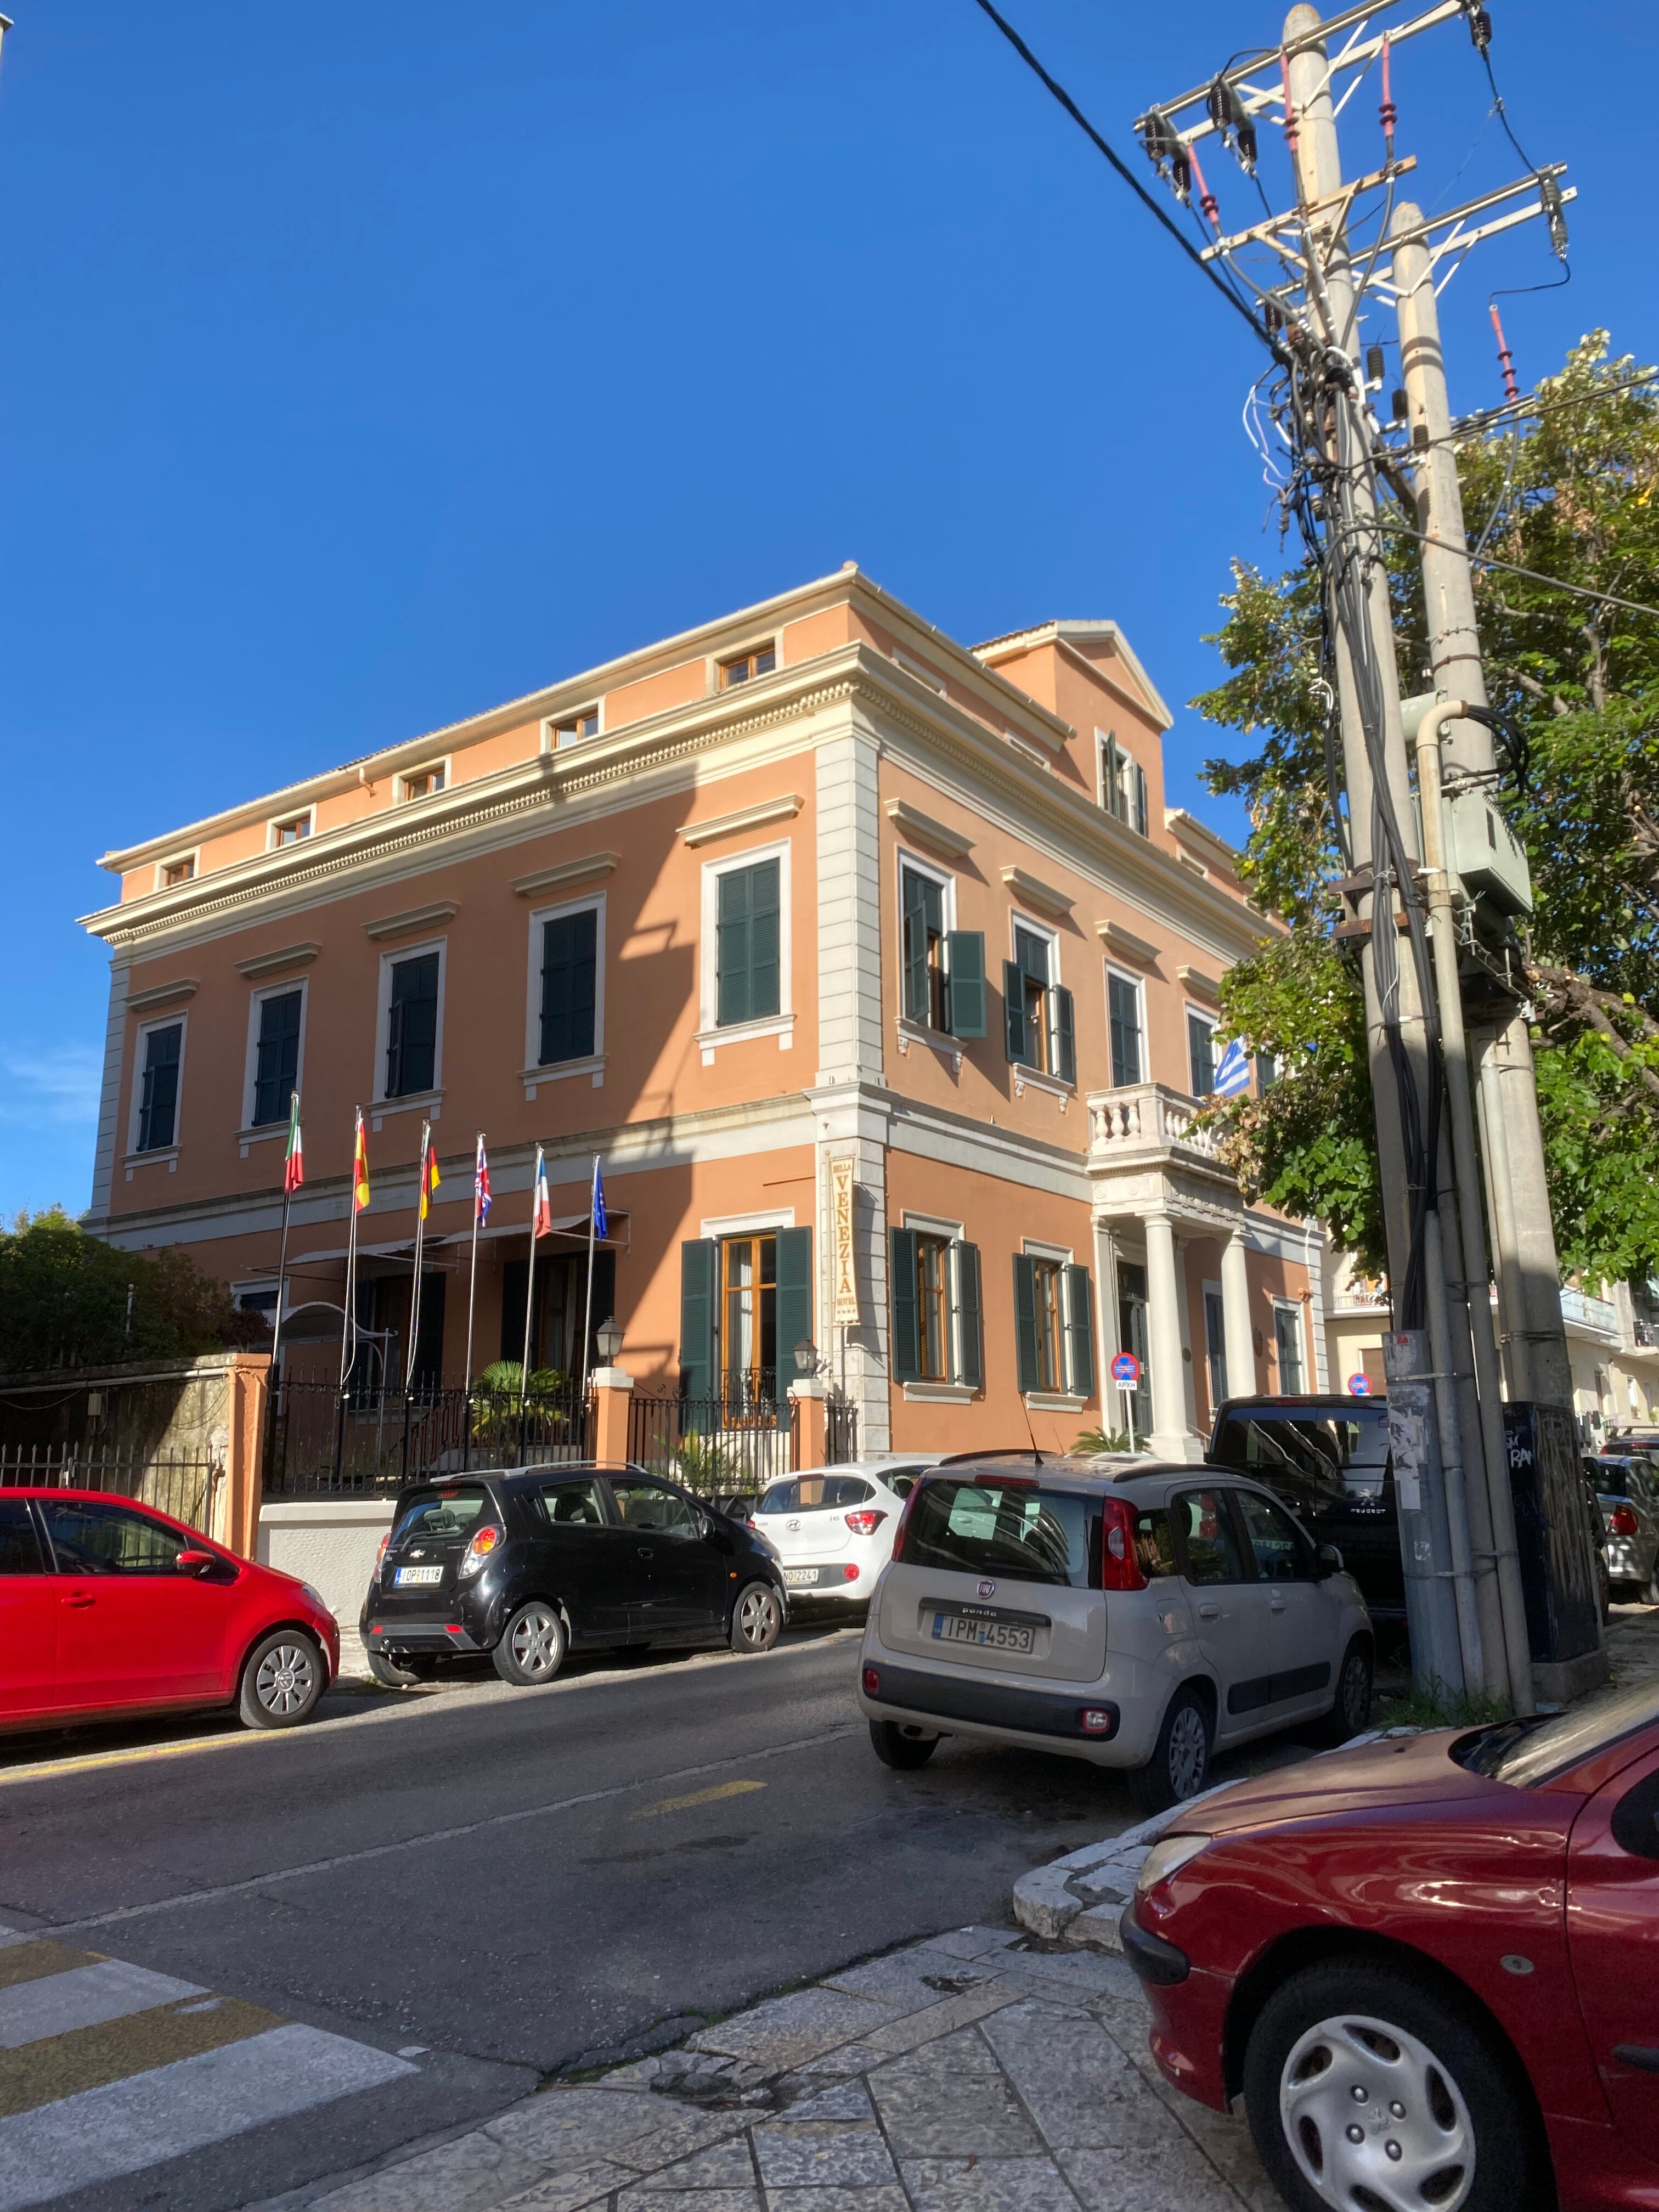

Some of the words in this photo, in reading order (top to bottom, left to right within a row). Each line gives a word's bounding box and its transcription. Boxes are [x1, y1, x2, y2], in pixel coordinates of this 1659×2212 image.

[833, 1164, 851, 1172] BELLA
[836, 1175, 851, 1294] VENEZIA
[837, 1297, 855, 1306] HOTEL
[783, 1571, 816, 1581] NO-2241
[980, 1583, 992, 1593] FIAT
[962, 1607, 997, 1617] panda
